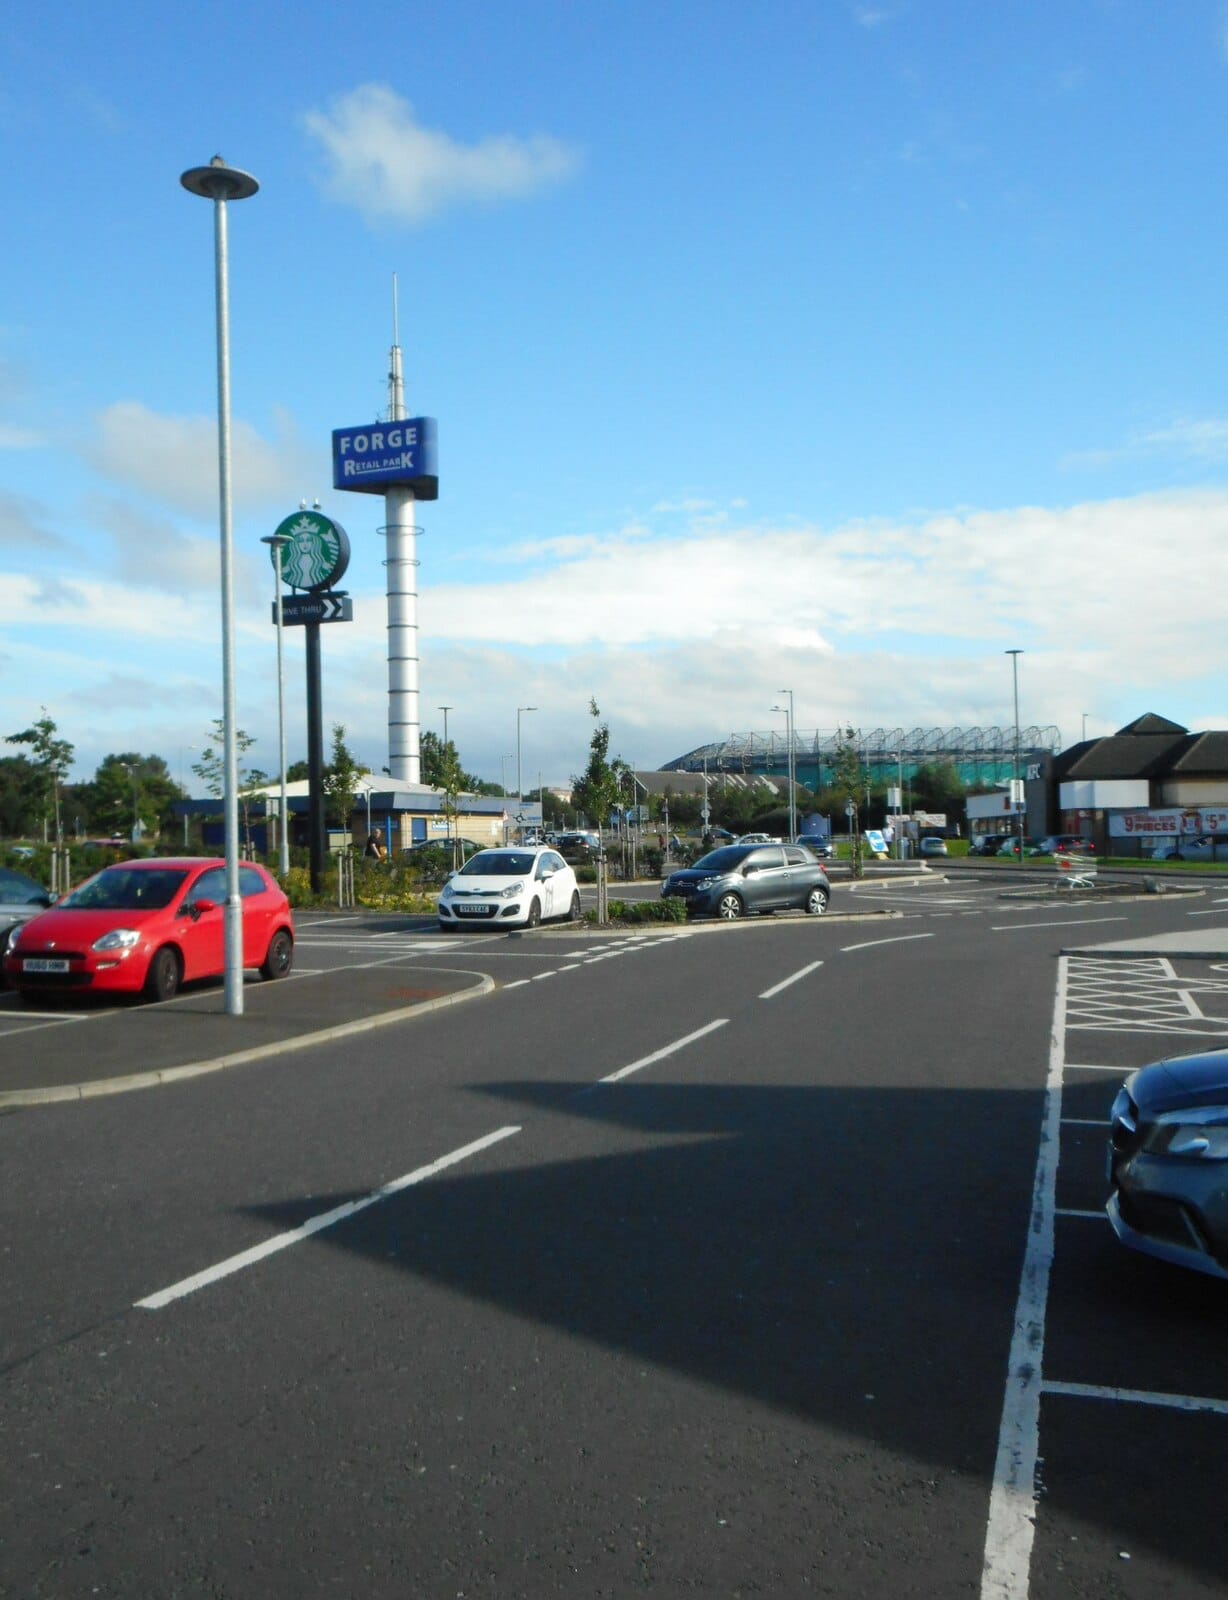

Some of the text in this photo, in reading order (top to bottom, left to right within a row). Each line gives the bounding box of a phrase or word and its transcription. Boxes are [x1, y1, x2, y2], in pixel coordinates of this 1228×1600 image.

[340, 427, 417, 455] FORGE
[344, 451, 414, 477] RETAIL PARK
[1135, 822, 1177, 832] PIECES
